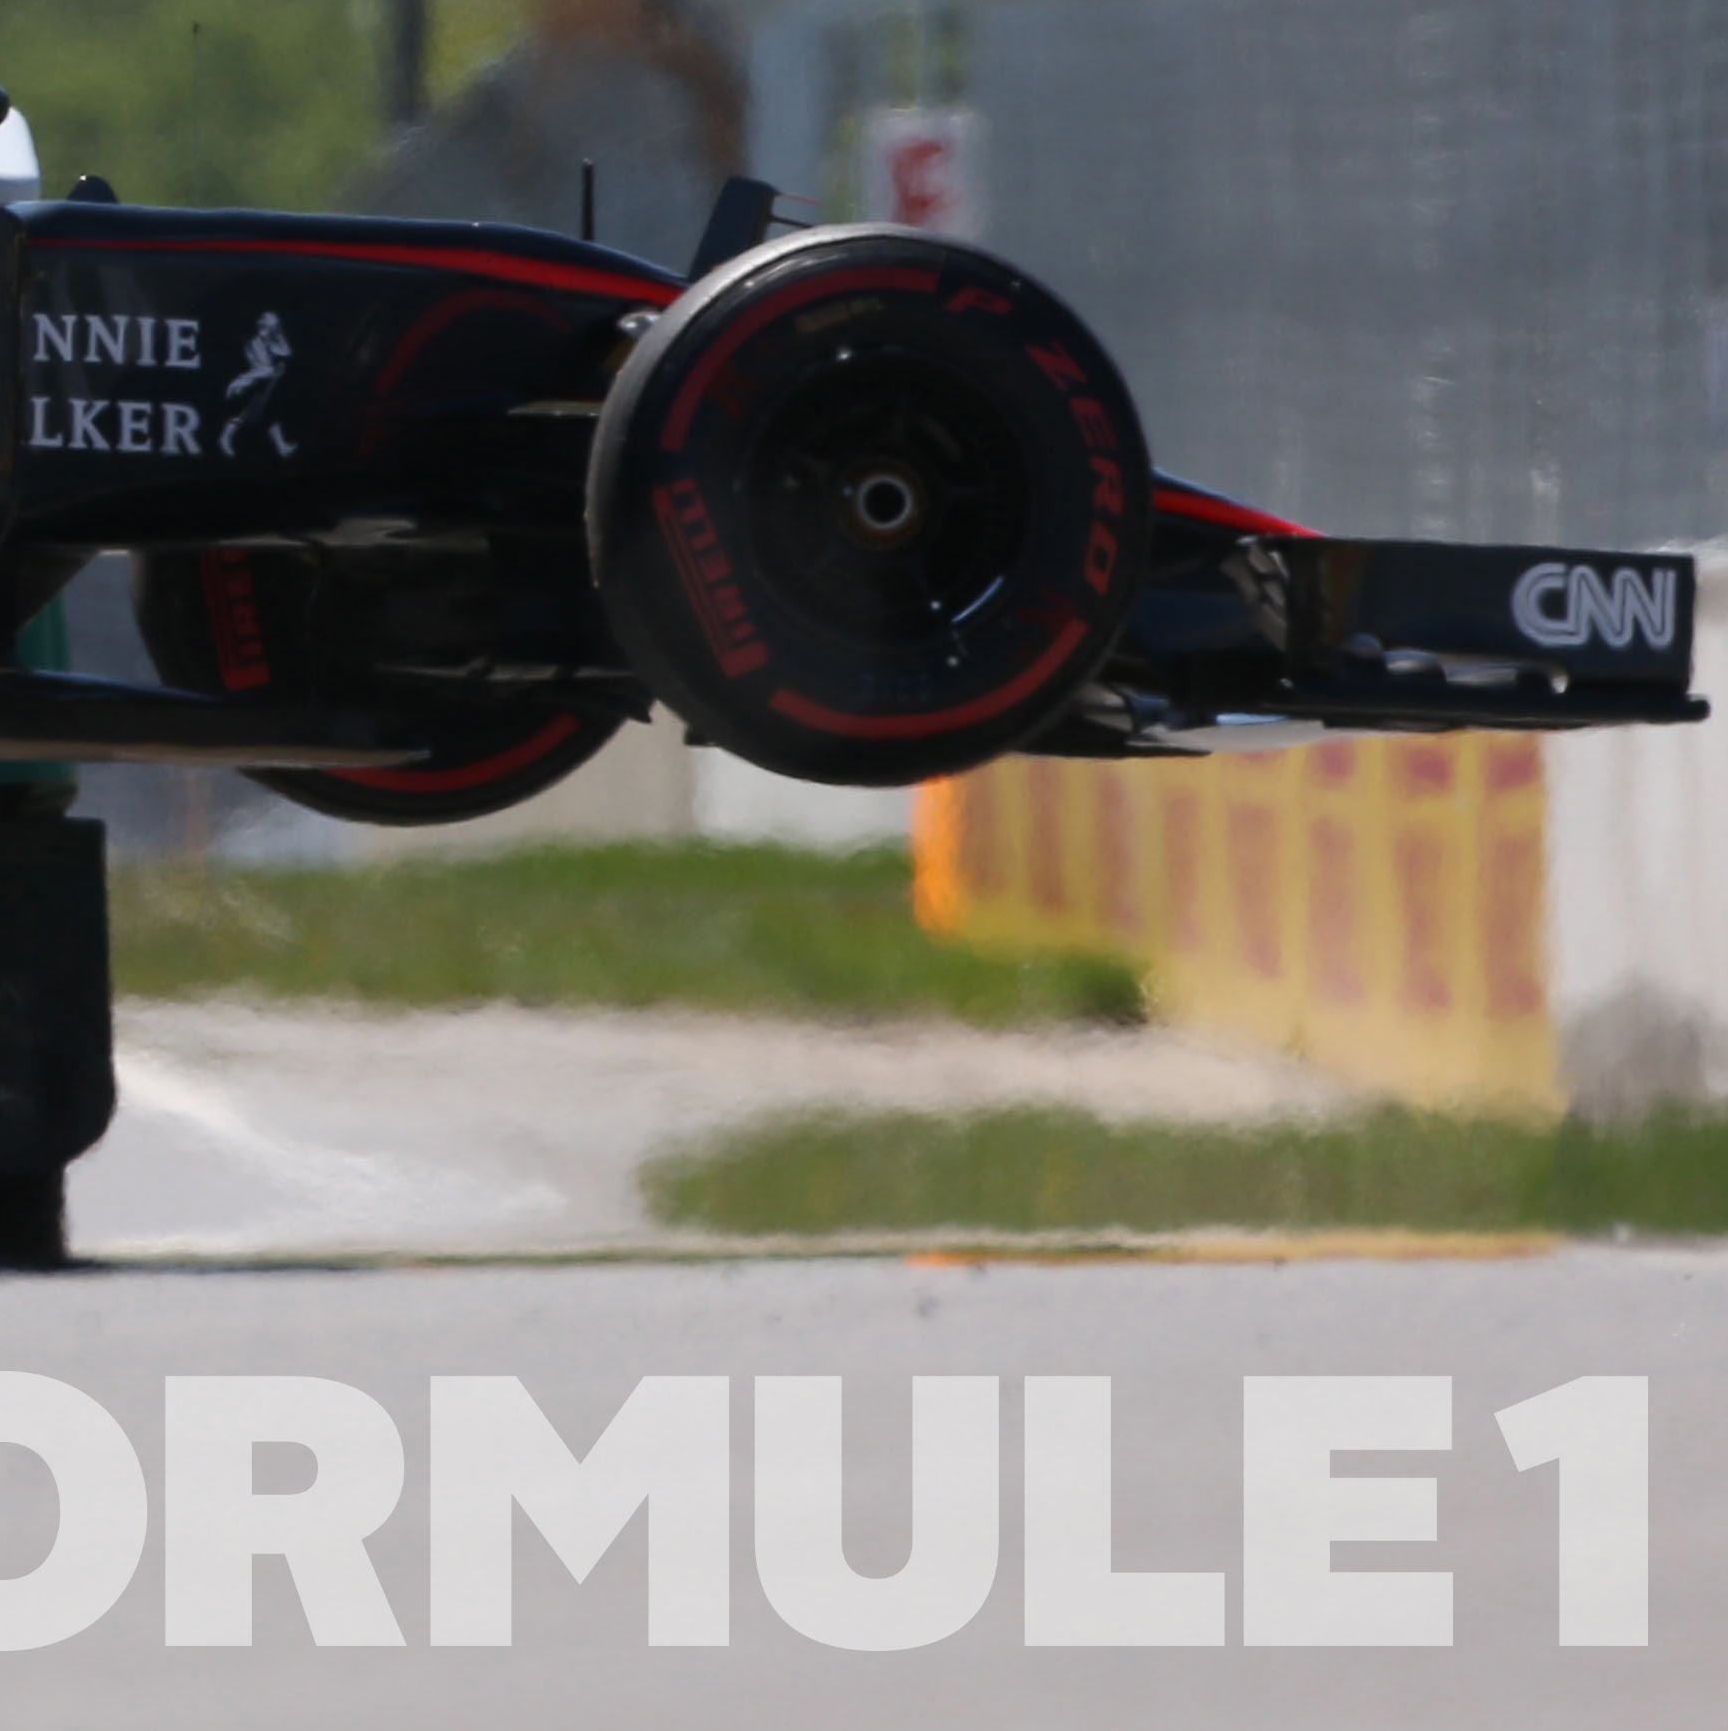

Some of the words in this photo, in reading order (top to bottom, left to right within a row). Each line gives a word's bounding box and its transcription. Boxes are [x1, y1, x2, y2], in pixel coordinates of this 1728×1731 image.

[32, 313, 201, 368] NNIE
[23, 396, 202, 455] LKER
[1027, 341, 1125, 596] ZERO
[651, 476, 769, 679] PIRELLI
[1510, 562, 1678, 651] CNN
